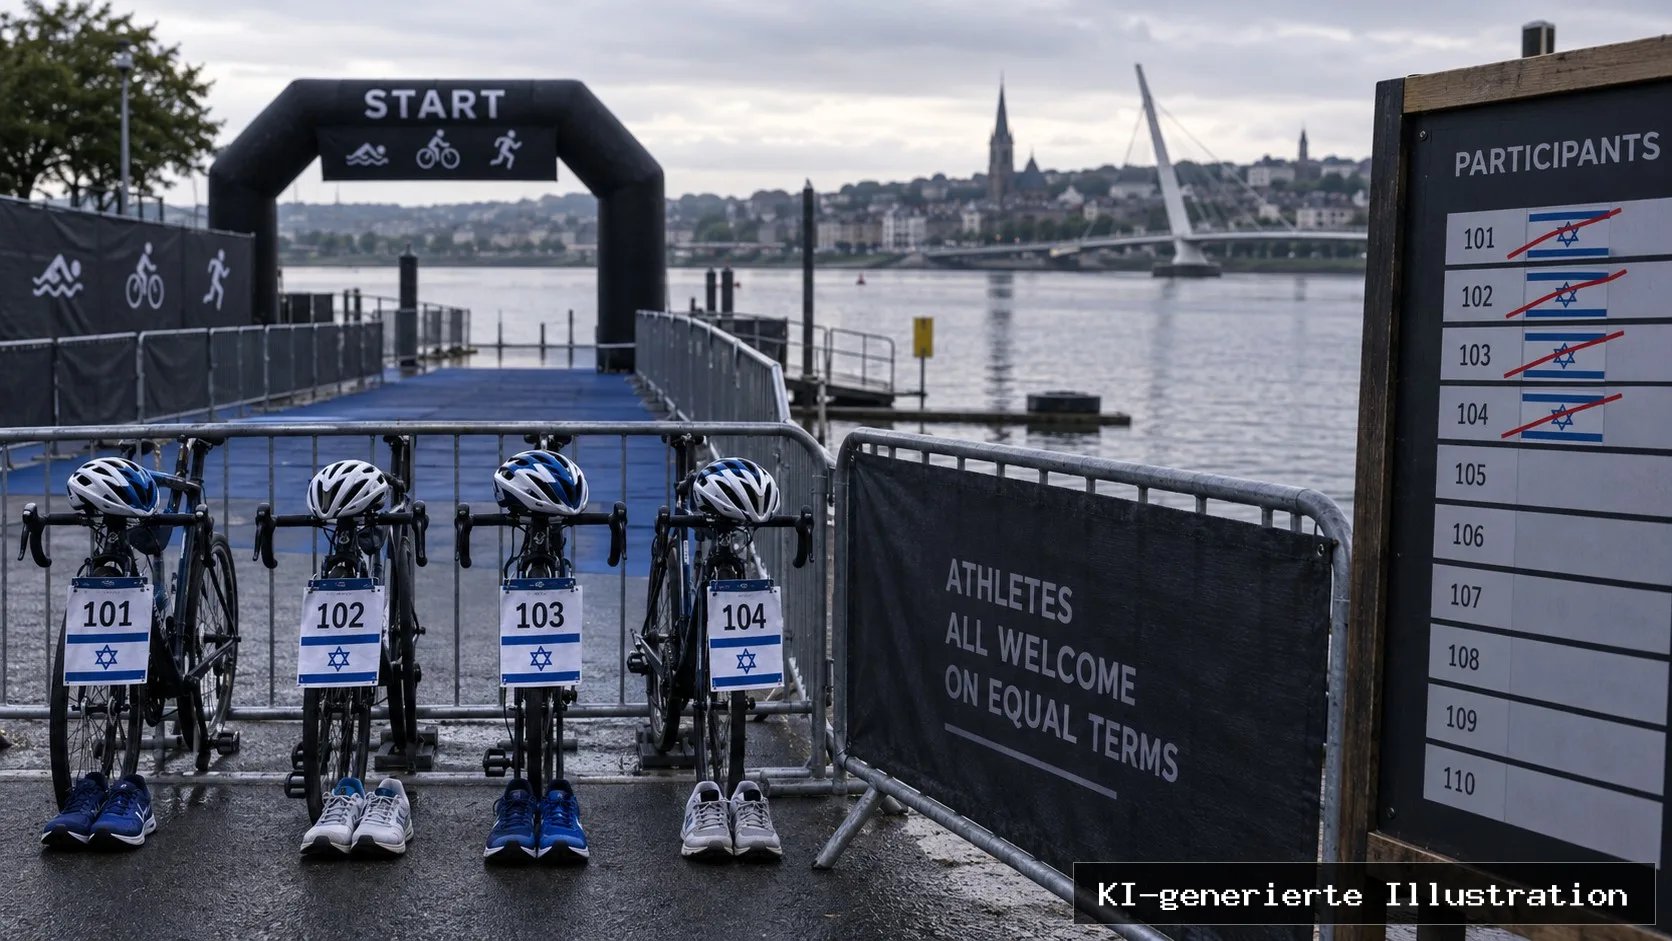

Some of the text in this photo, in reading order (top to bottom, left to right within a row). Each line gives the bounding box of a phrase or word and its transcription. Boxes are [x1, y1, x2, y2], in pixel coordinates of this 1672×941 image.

[364, 89, 505, 119] START
[1455, 131, 1661, 177] PARTICIPANTS
[1464, 226, 1495, 249] 101
[1461, 285, 1493, 308] 102
[1459, 343, 1491, 366] 103
[1457, 402, 1488, 425] 104
[1455, 463, 1486, 487] 105
[1453, 523, 1484, 547] 106
[945, 558, 1073, 624] ATHLETES
[1450, 583, 1482, 608] 107
[83, 600, 132, 627] 101
[316, 601, 364, 629] 102
[516, 601, 564, 629] 103
[723, 603, 766, 630] 104
[945, 612, 1136, 706] ALL WELCOME
[1448, 644, 1480, 670] 108
[945, 664, 1179, 783] ON EQUAL TERMS
[1446, 705, 1477, 732] 109
[1443, 767, 1475, 795] 110
